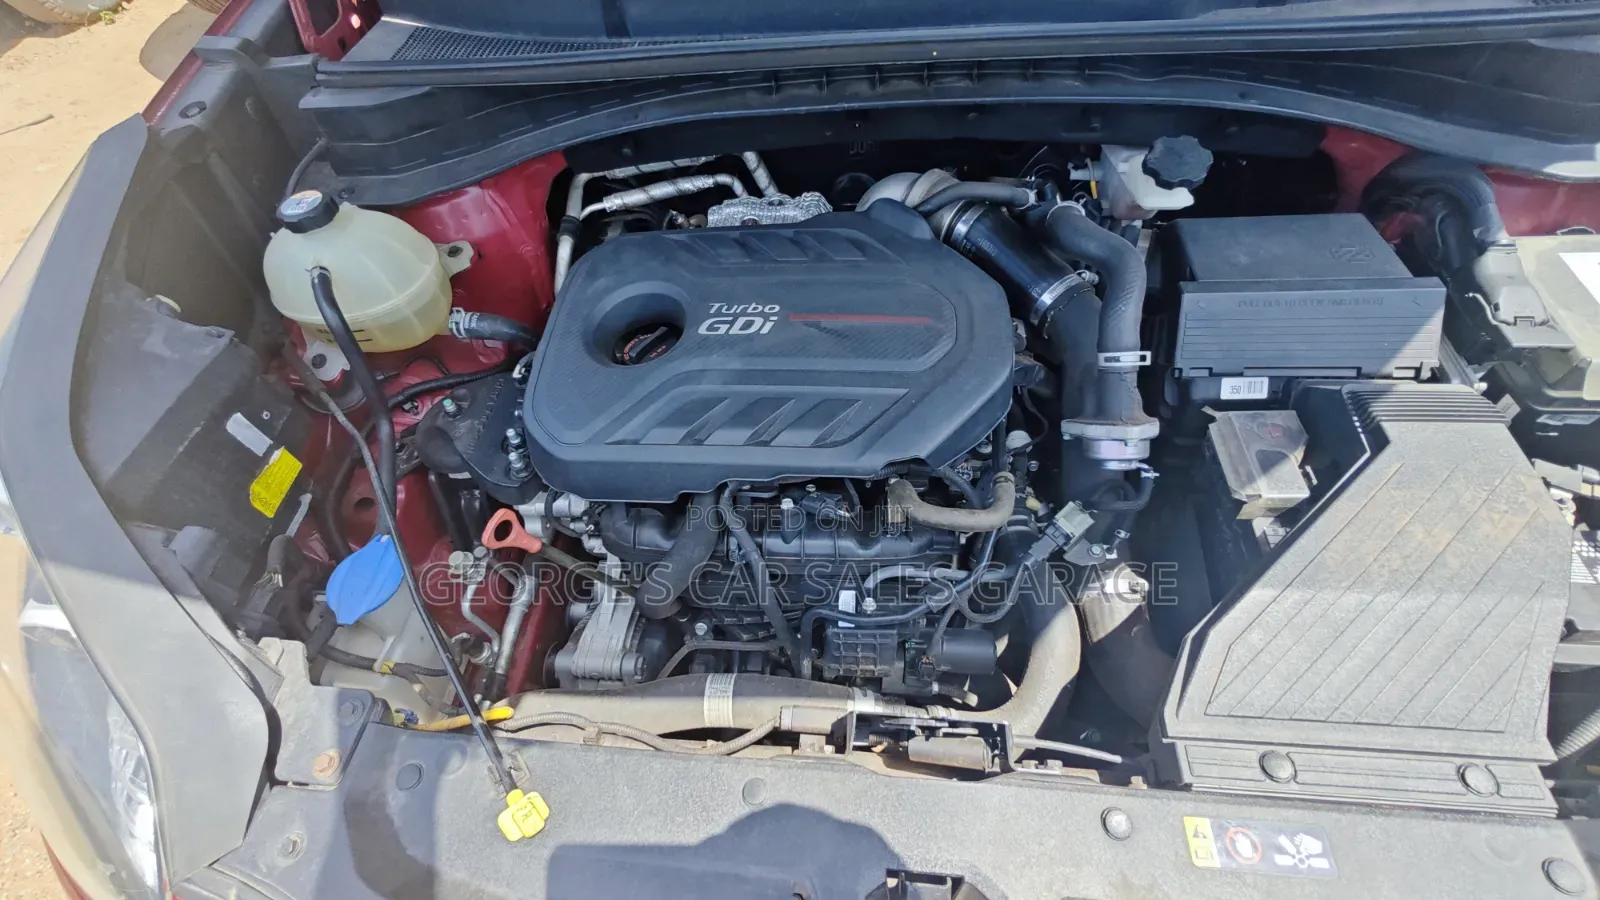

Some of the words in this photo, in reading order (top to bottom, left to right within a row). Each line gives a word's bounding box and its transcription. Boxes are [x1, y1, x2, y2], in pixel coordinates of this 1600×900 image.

[709, 302, 780, 314] Turbo
[697, 316, 779, 335] GDi
[1229, 385, 1242, 395] 350
